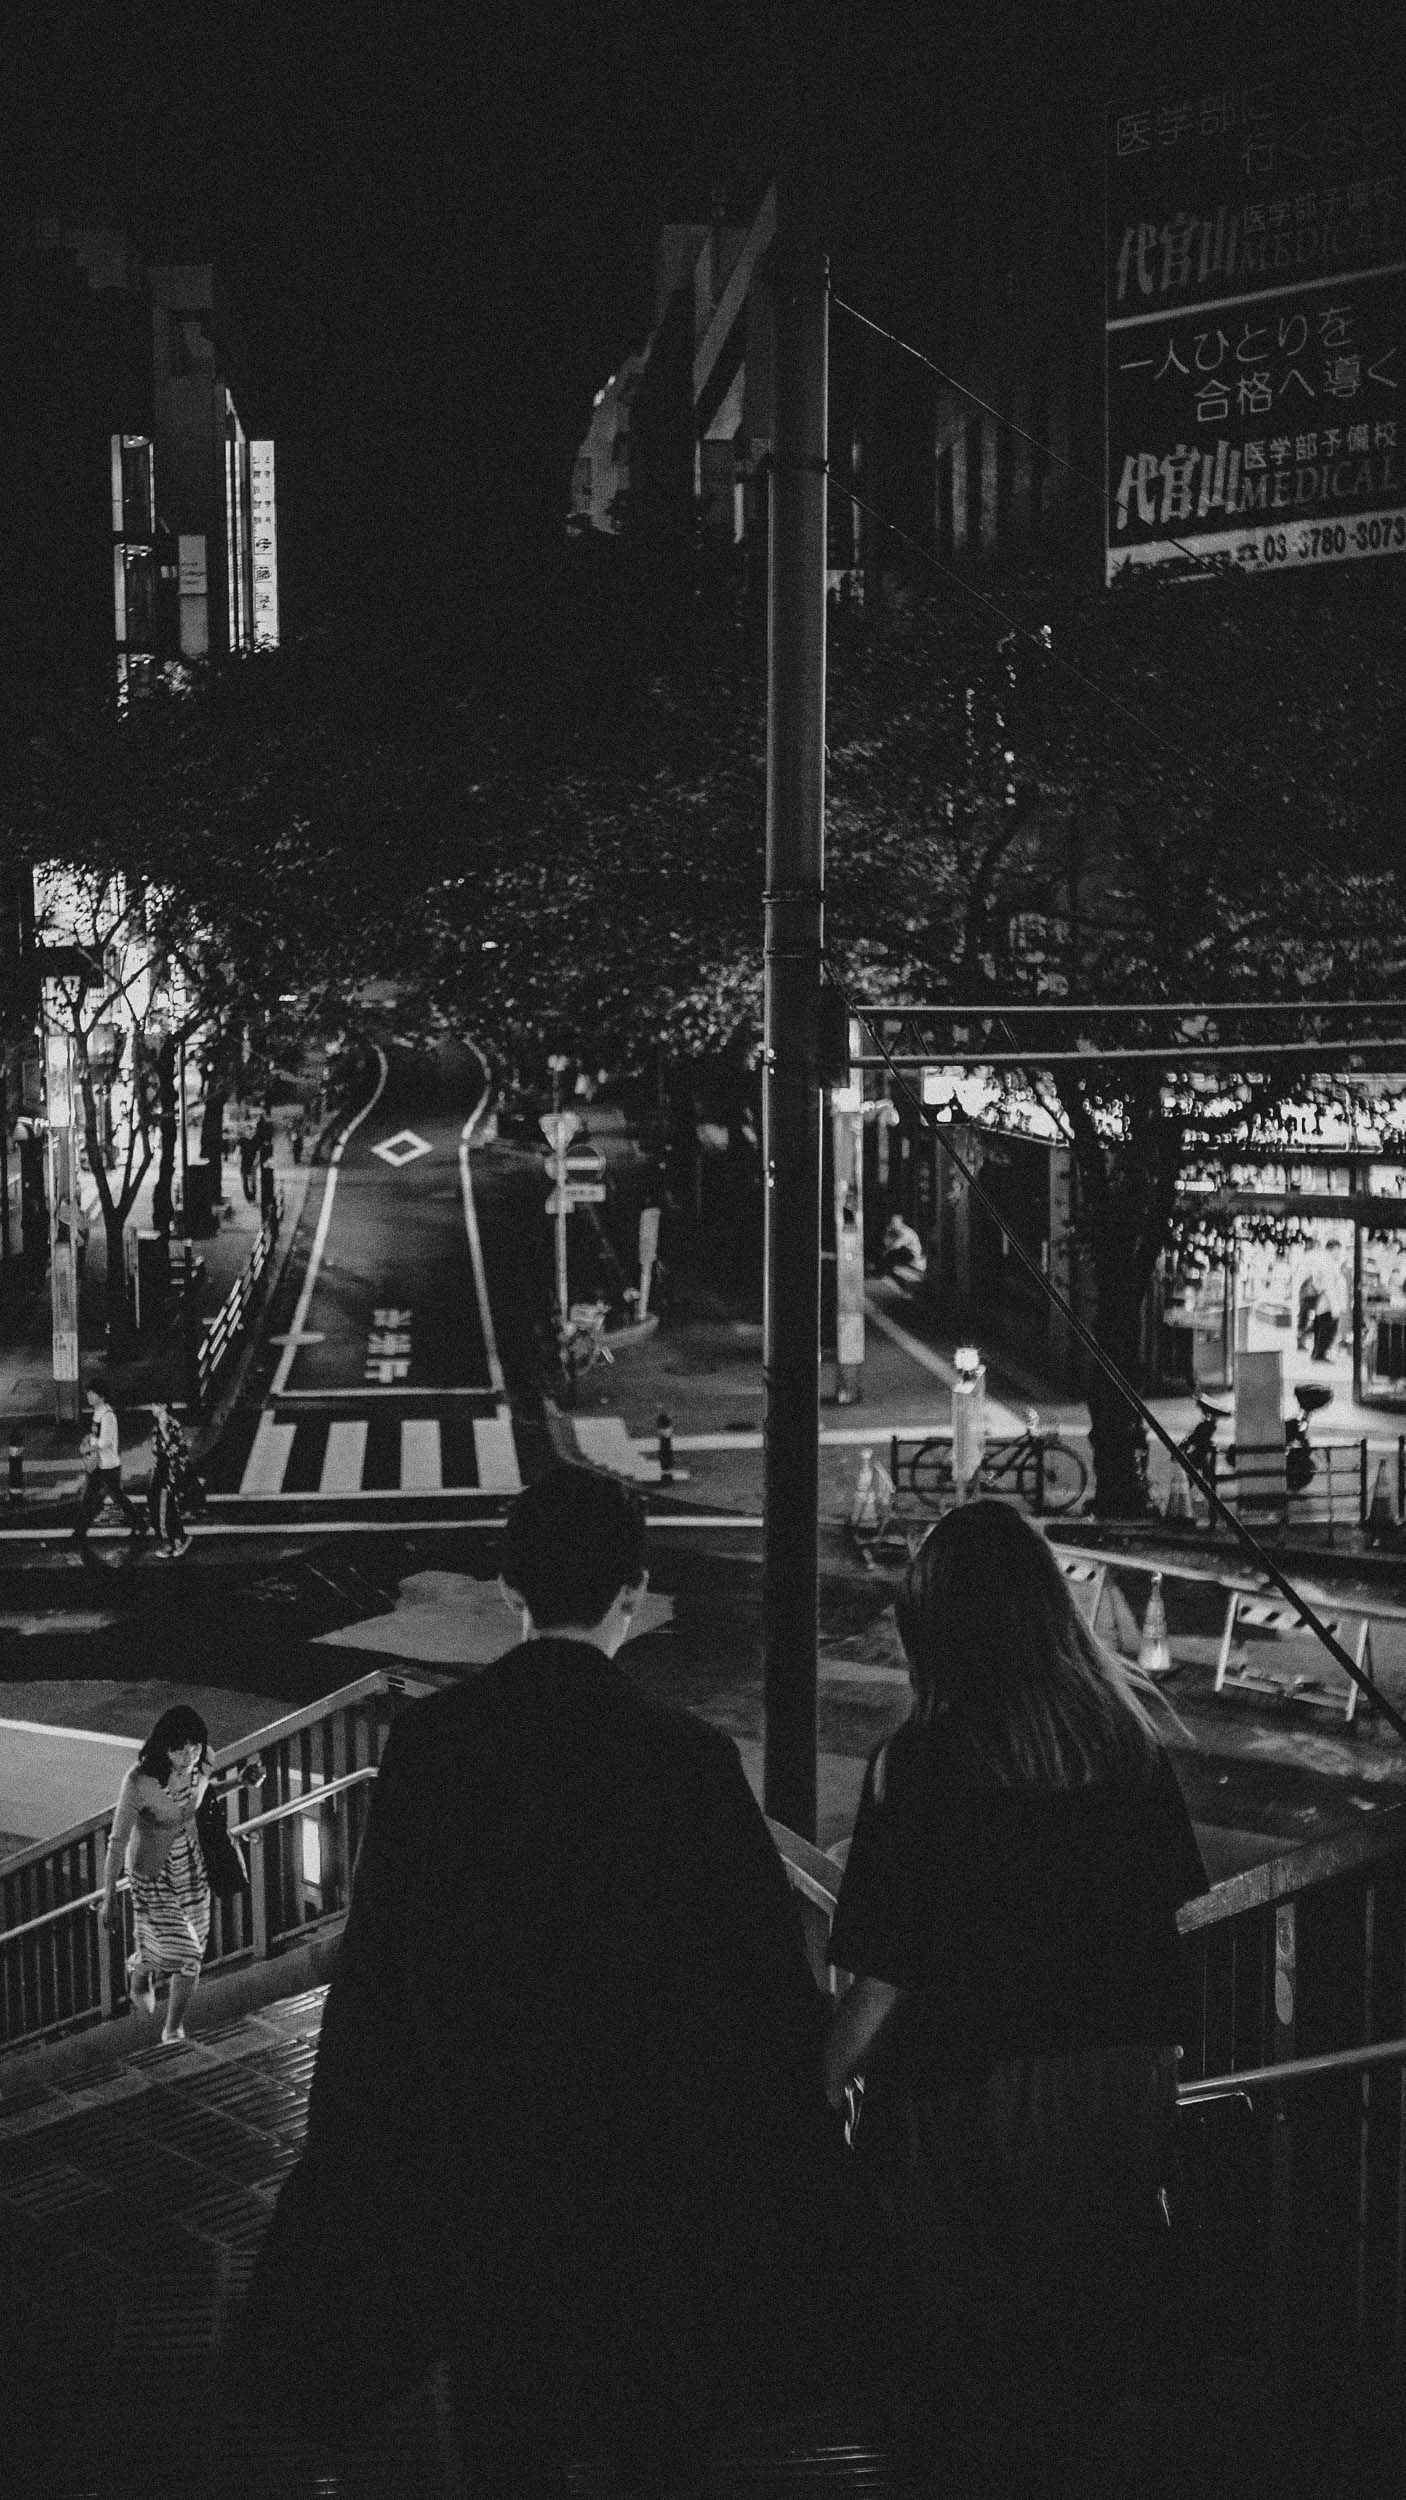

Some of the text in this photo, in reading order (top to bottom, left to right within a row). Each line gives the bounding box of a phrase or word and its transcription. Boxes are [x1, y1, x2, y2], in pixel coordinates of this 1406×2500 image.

[1116, 206, 1239, 301] 代官山
[1239, 214, 1394, 275] MEDICAL
[1119, 306, 1352, 380] 一人ひとりを
[1194, 348, 1398, 422] 合格へ導く
[1244, 420, 1398, 471] 医学部予備校
[1116, 440, 1241, 530] 代官山
[1237, 455, 1399, 512] MEDICAL
